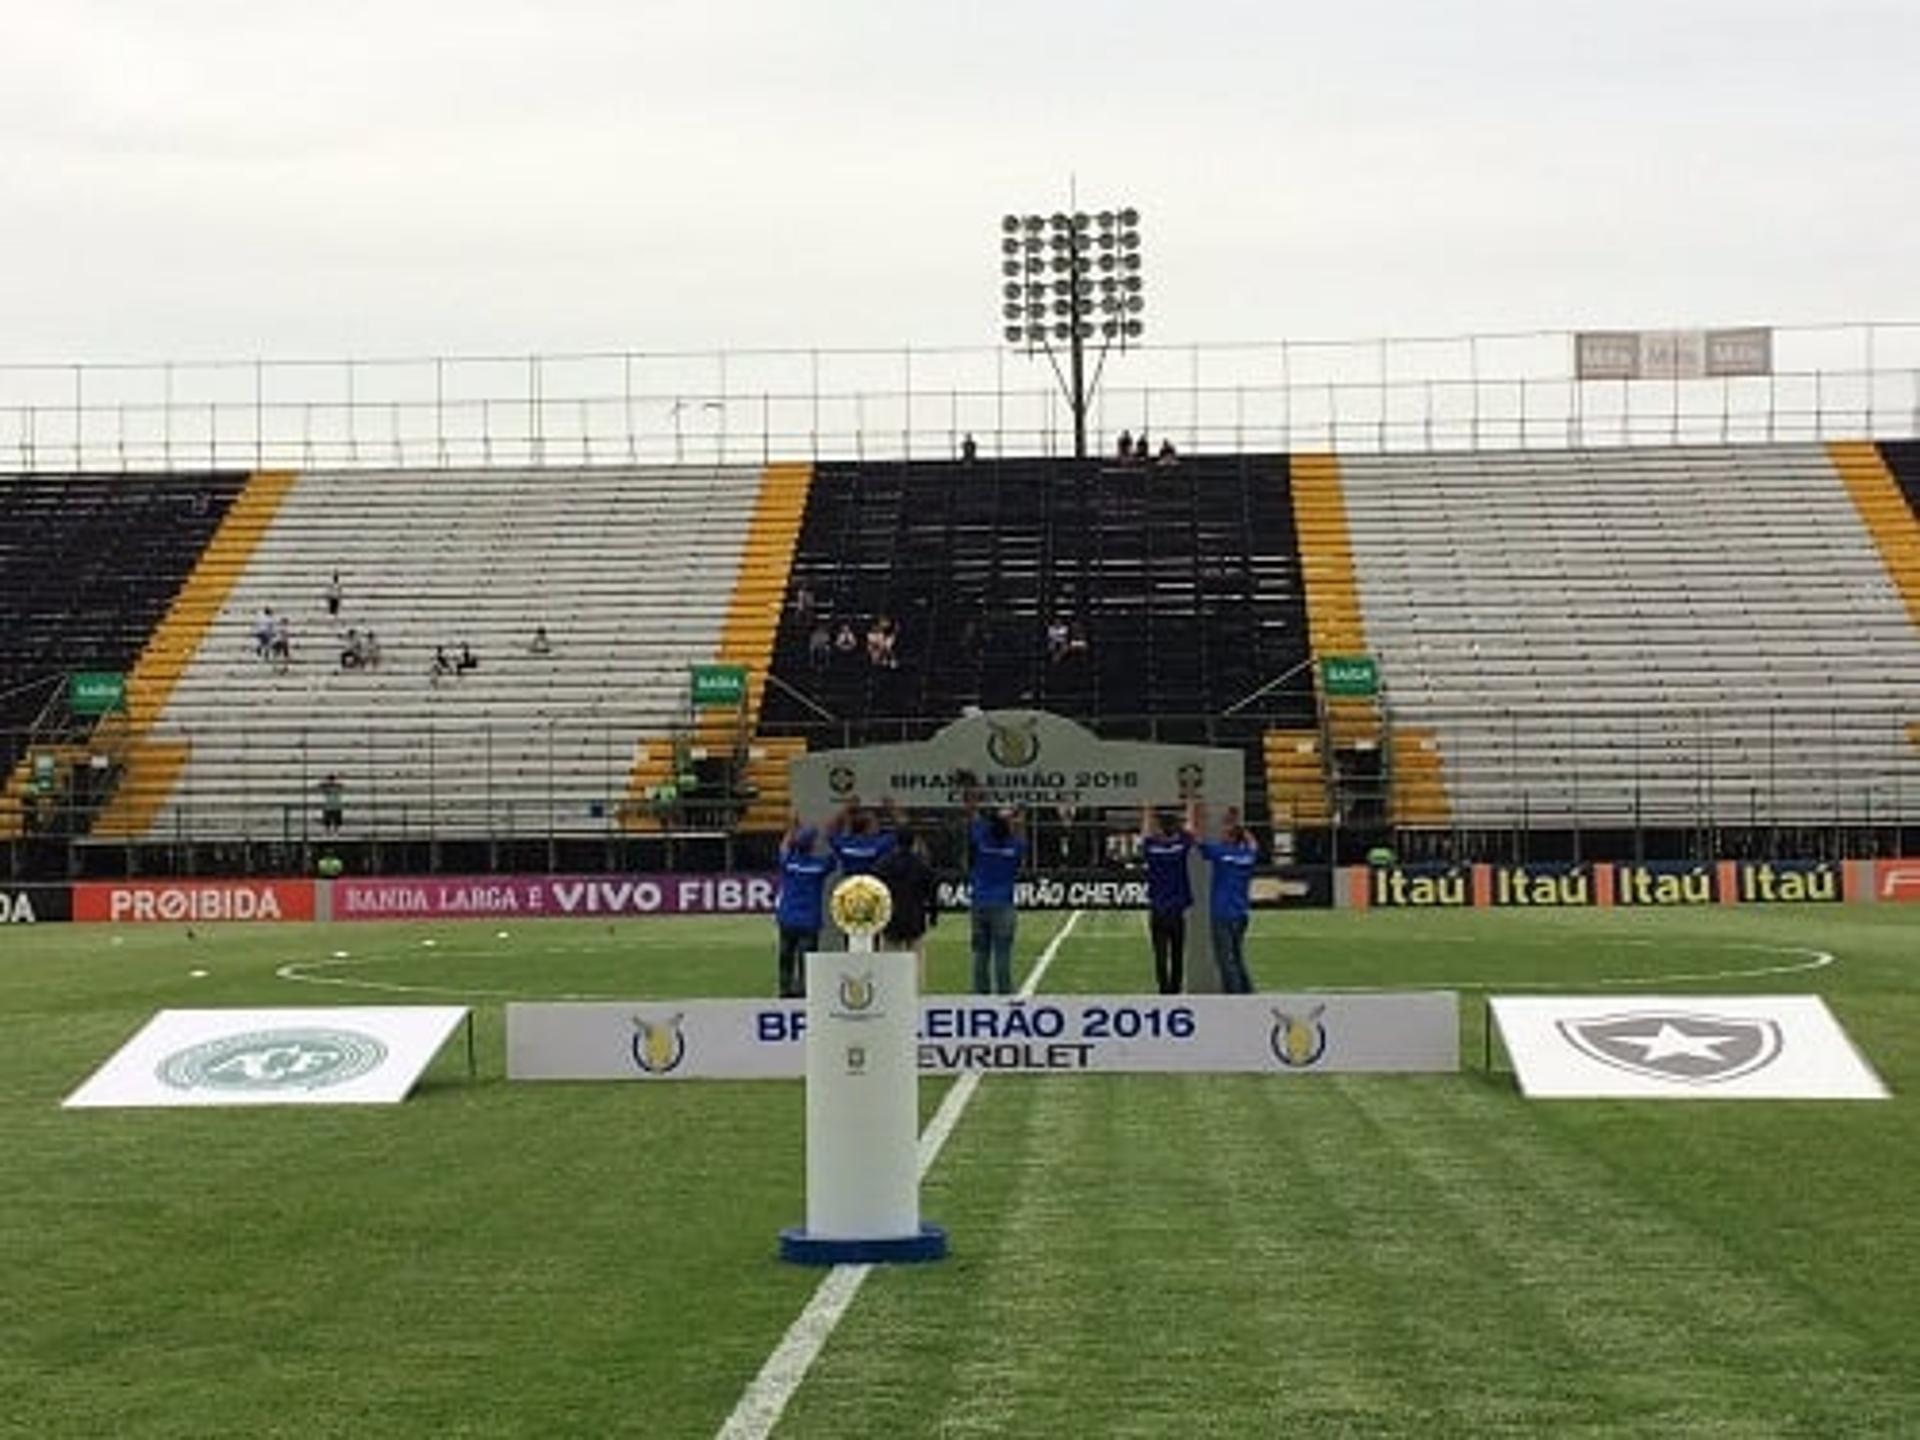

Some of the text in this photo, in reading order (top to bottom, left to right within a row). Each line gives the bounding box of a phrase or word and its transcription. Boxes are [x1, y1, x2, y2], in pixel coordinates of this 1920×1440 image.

[1074, 771, 1138, 788] 2016
[552, 880, 662, 911] VIVO
[677, 878, 782, 909] FIBR
[1376, 867, 1465, 904] Itaú
[1500, 866, 1588, 904] Itaú
[1619, 866, 1710, 903] Itaú
[1744, 863, 1835, 900] Itaú
[1083, 1008, 1196, 1038] 2016
